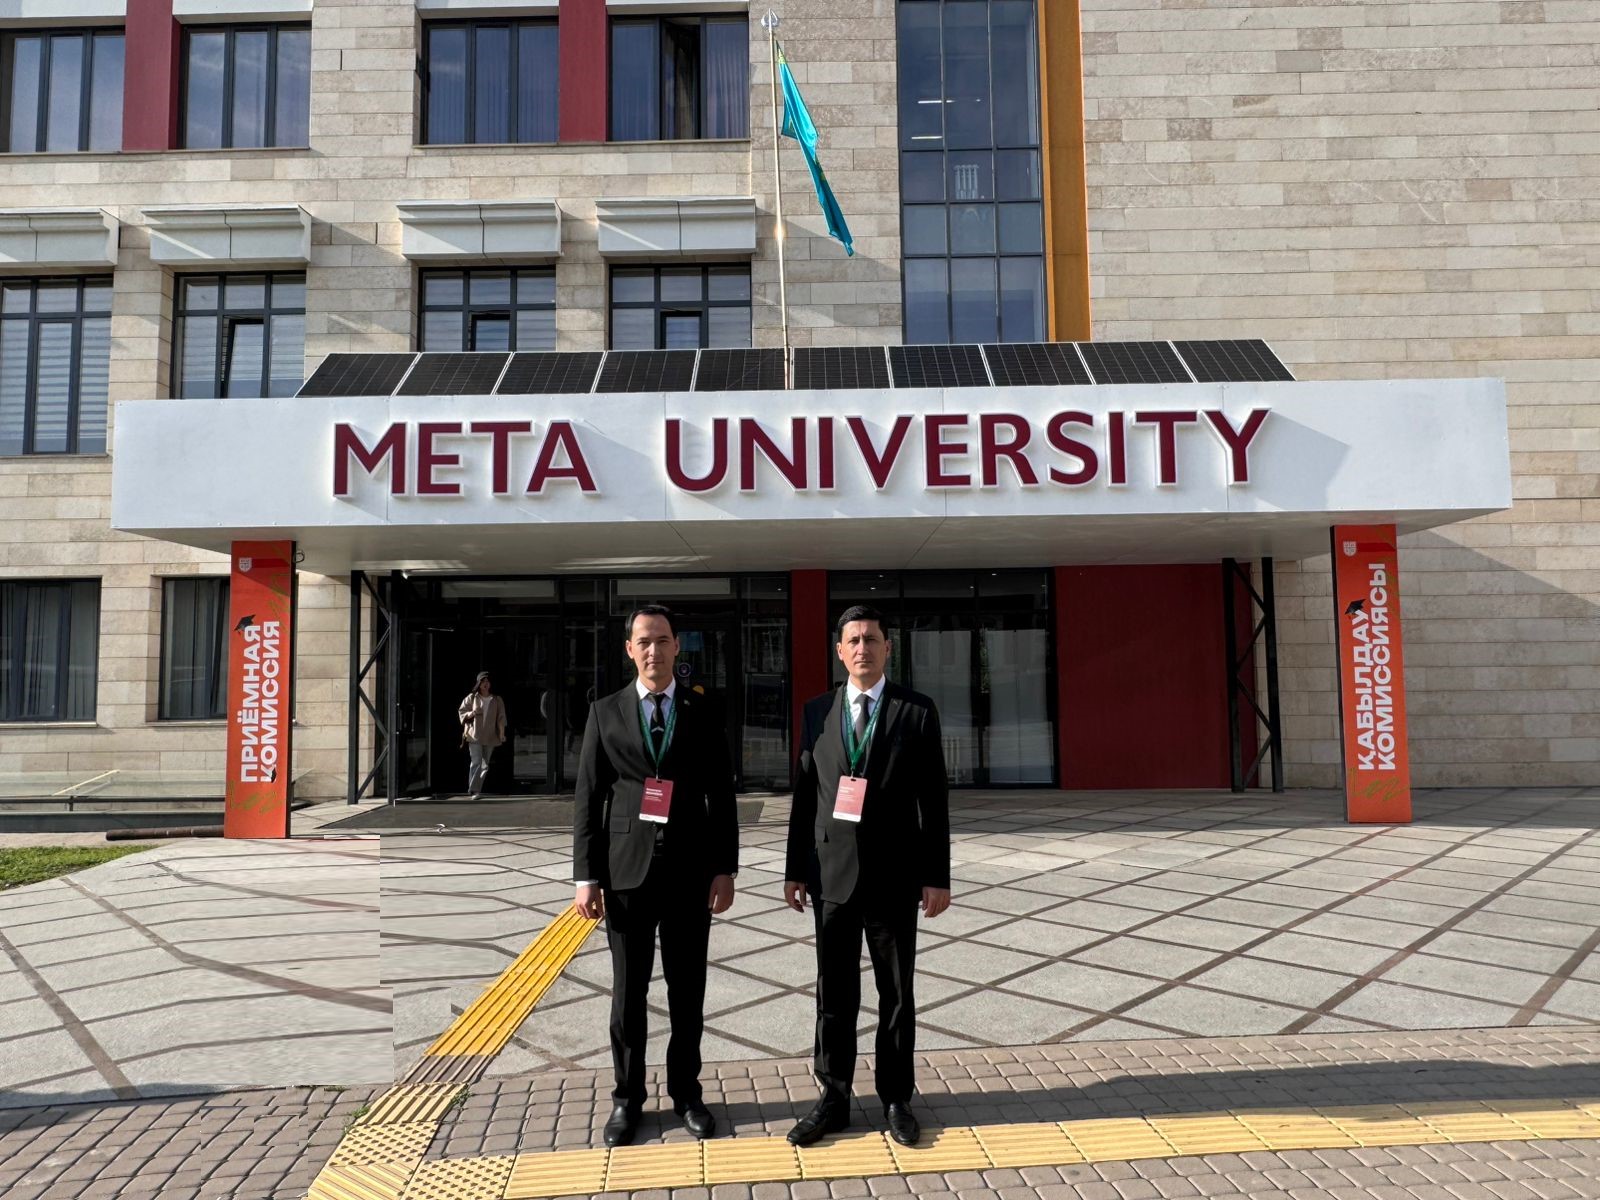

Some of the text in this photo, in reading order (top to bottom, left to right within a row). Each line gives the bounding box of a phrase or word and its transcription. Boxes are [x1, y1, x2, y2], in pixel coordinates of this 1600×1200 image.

[333, 408, 1271, 497] META UNIVERSITY
[237, 625, 261, 783] ПРИЁМНАЯ
[260, 621, 280, 783] КОМИССИЯ
[1351, 609, 1377, 770] ҚАБЫЛДАУ
[1368, 563, 1396, 770] КОМИССИЯСЫ
